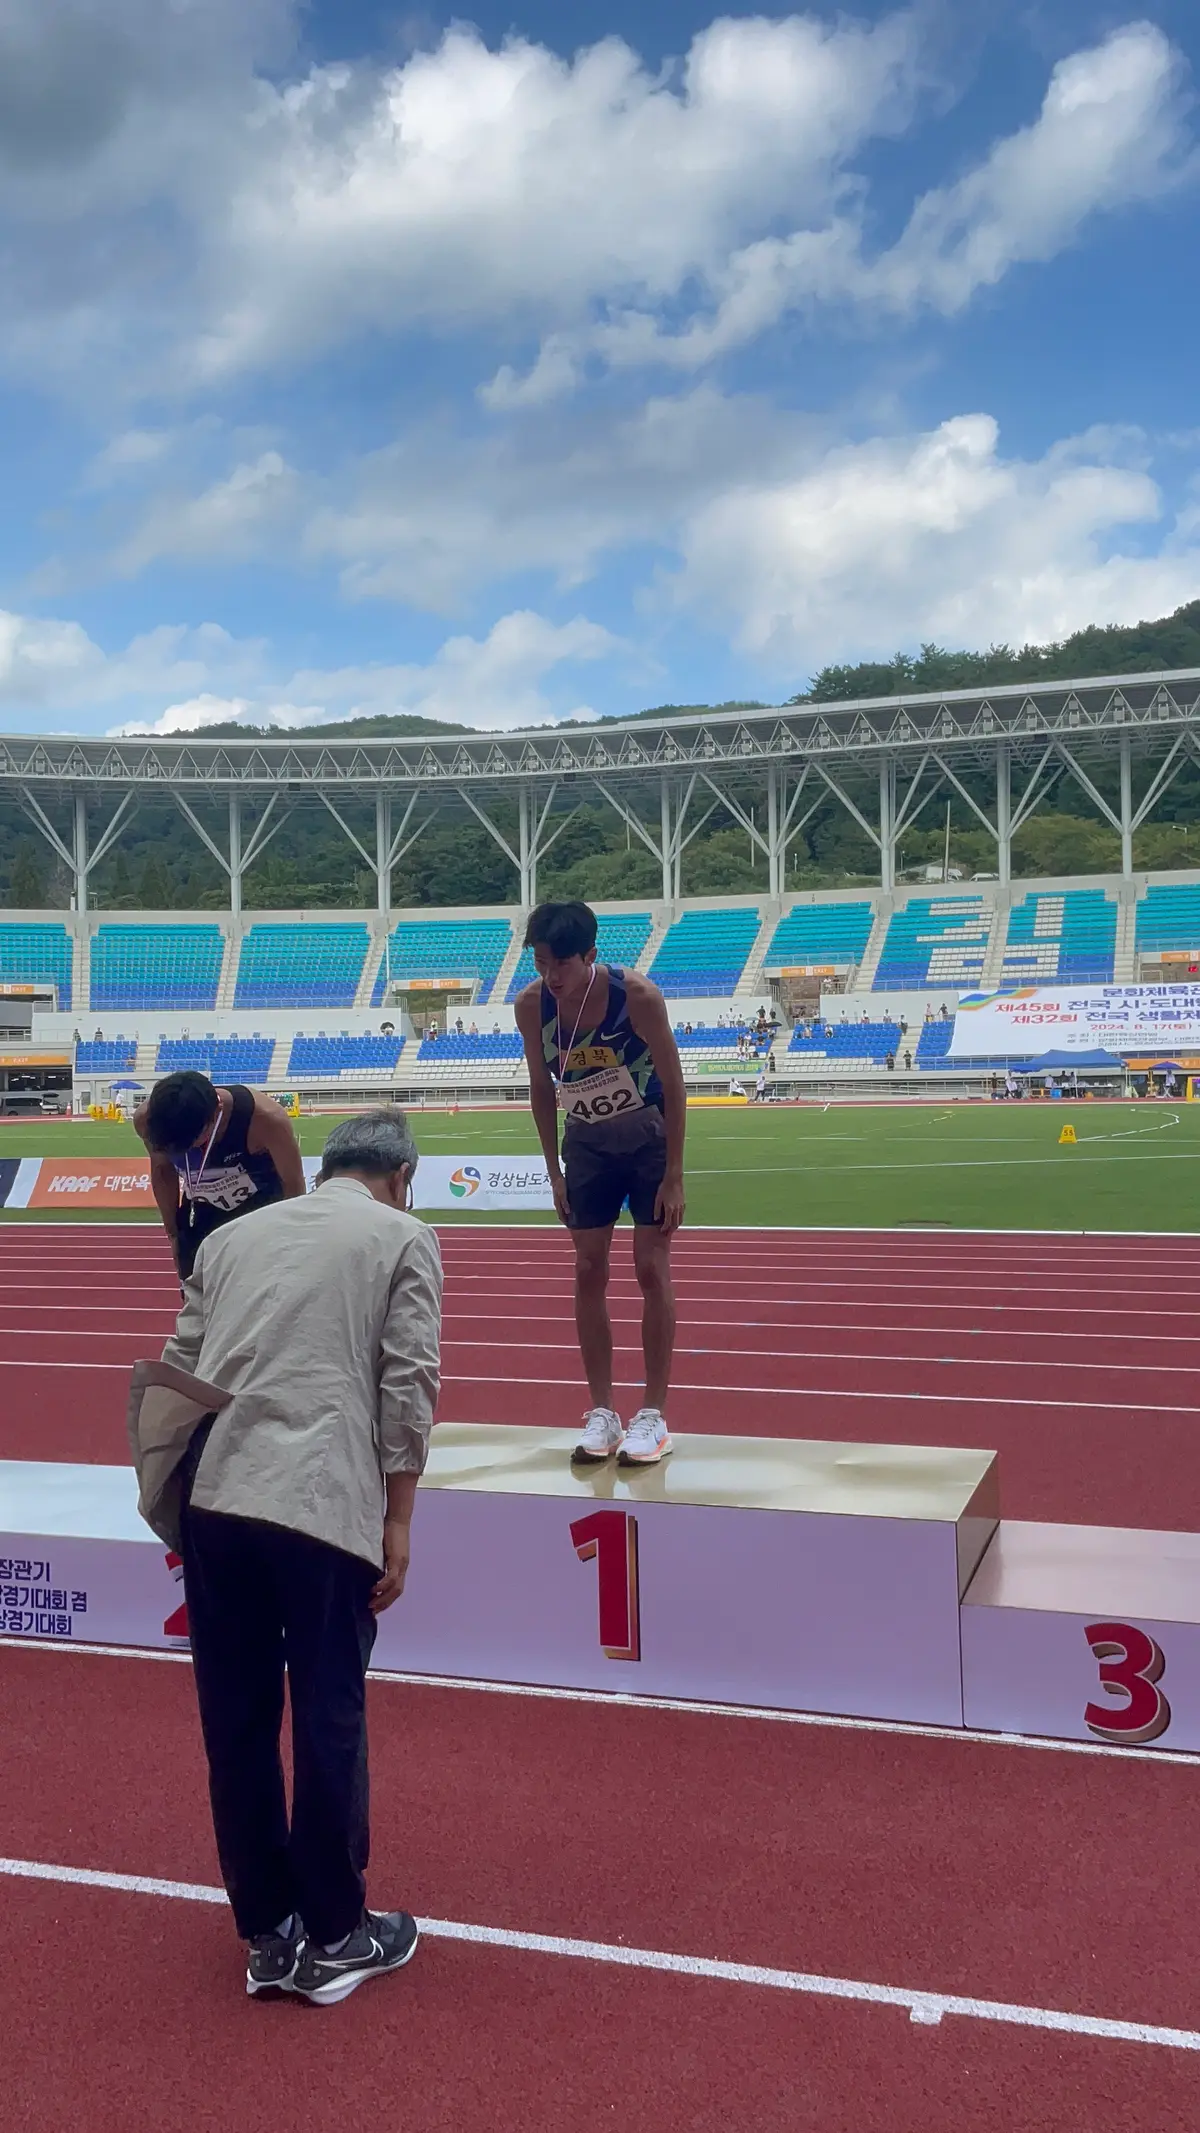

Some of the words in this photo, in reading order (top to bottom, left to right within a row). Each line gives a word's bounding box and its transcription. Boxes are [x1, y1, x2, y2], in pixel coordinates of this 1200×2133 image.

[995, 1002, 1060, 1013] 제45회
[1067, 1000, 1111, 1010] 전국
[1117, 998, 1200, 1009] 시·도대
[1011, 1014, 1078, 1025] 제32회
[1085, 1011, 1129, 1021] 전국
[571, 1088, 637, 1120] 462
[47, 1175, 101, 1193] KAAF
[0, 1584, 67, 1611] 경기대회
[71, 1590, 87, 1612] 겸
[569, 1509, 641, 1661] 1
[1083, 1621, 1170, 1742] 3
